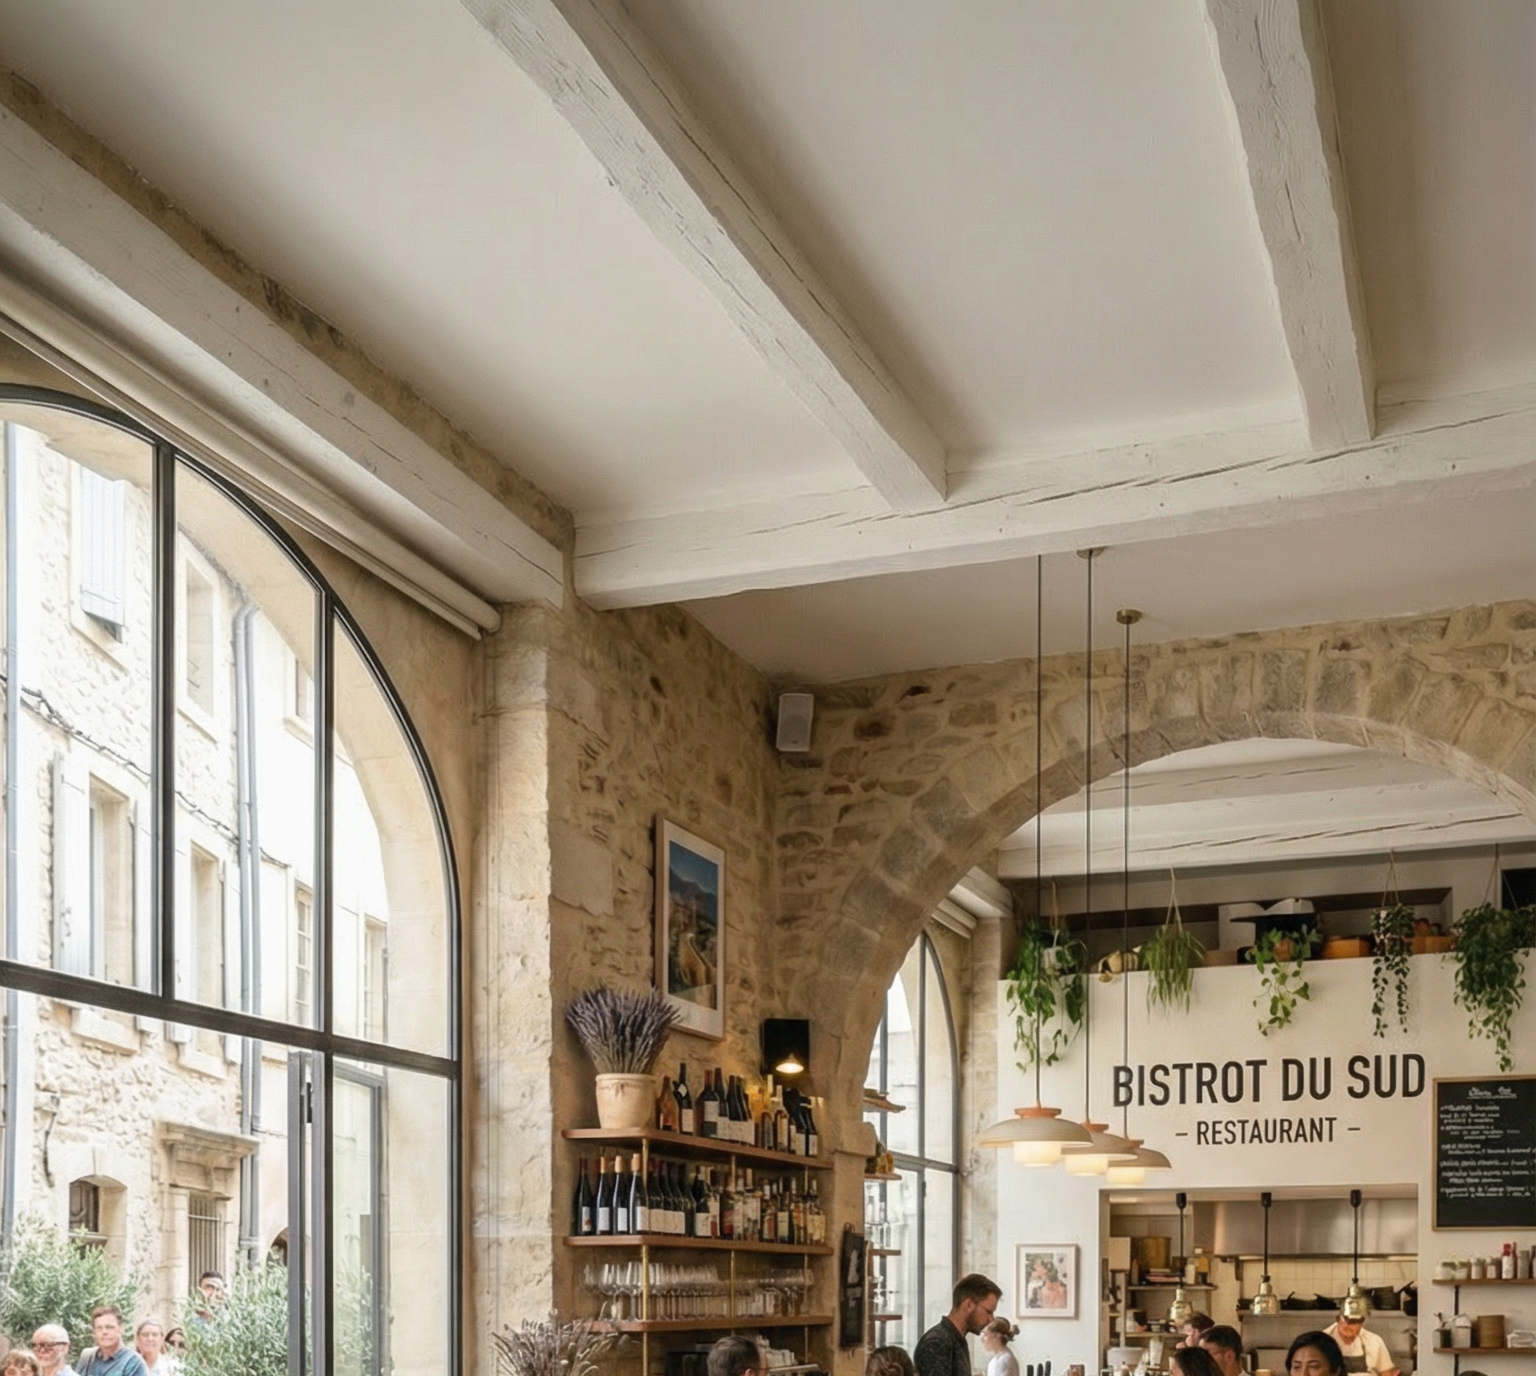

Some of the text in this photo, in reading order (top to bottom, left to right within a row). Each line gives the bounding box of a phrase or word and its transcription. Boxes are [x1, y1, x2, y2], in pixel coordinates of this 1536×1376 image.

[1113, 1053, 1426, 1107] BISTROT DU SUD
[1197, 1117, 1337, 1145] RESTAURANT
